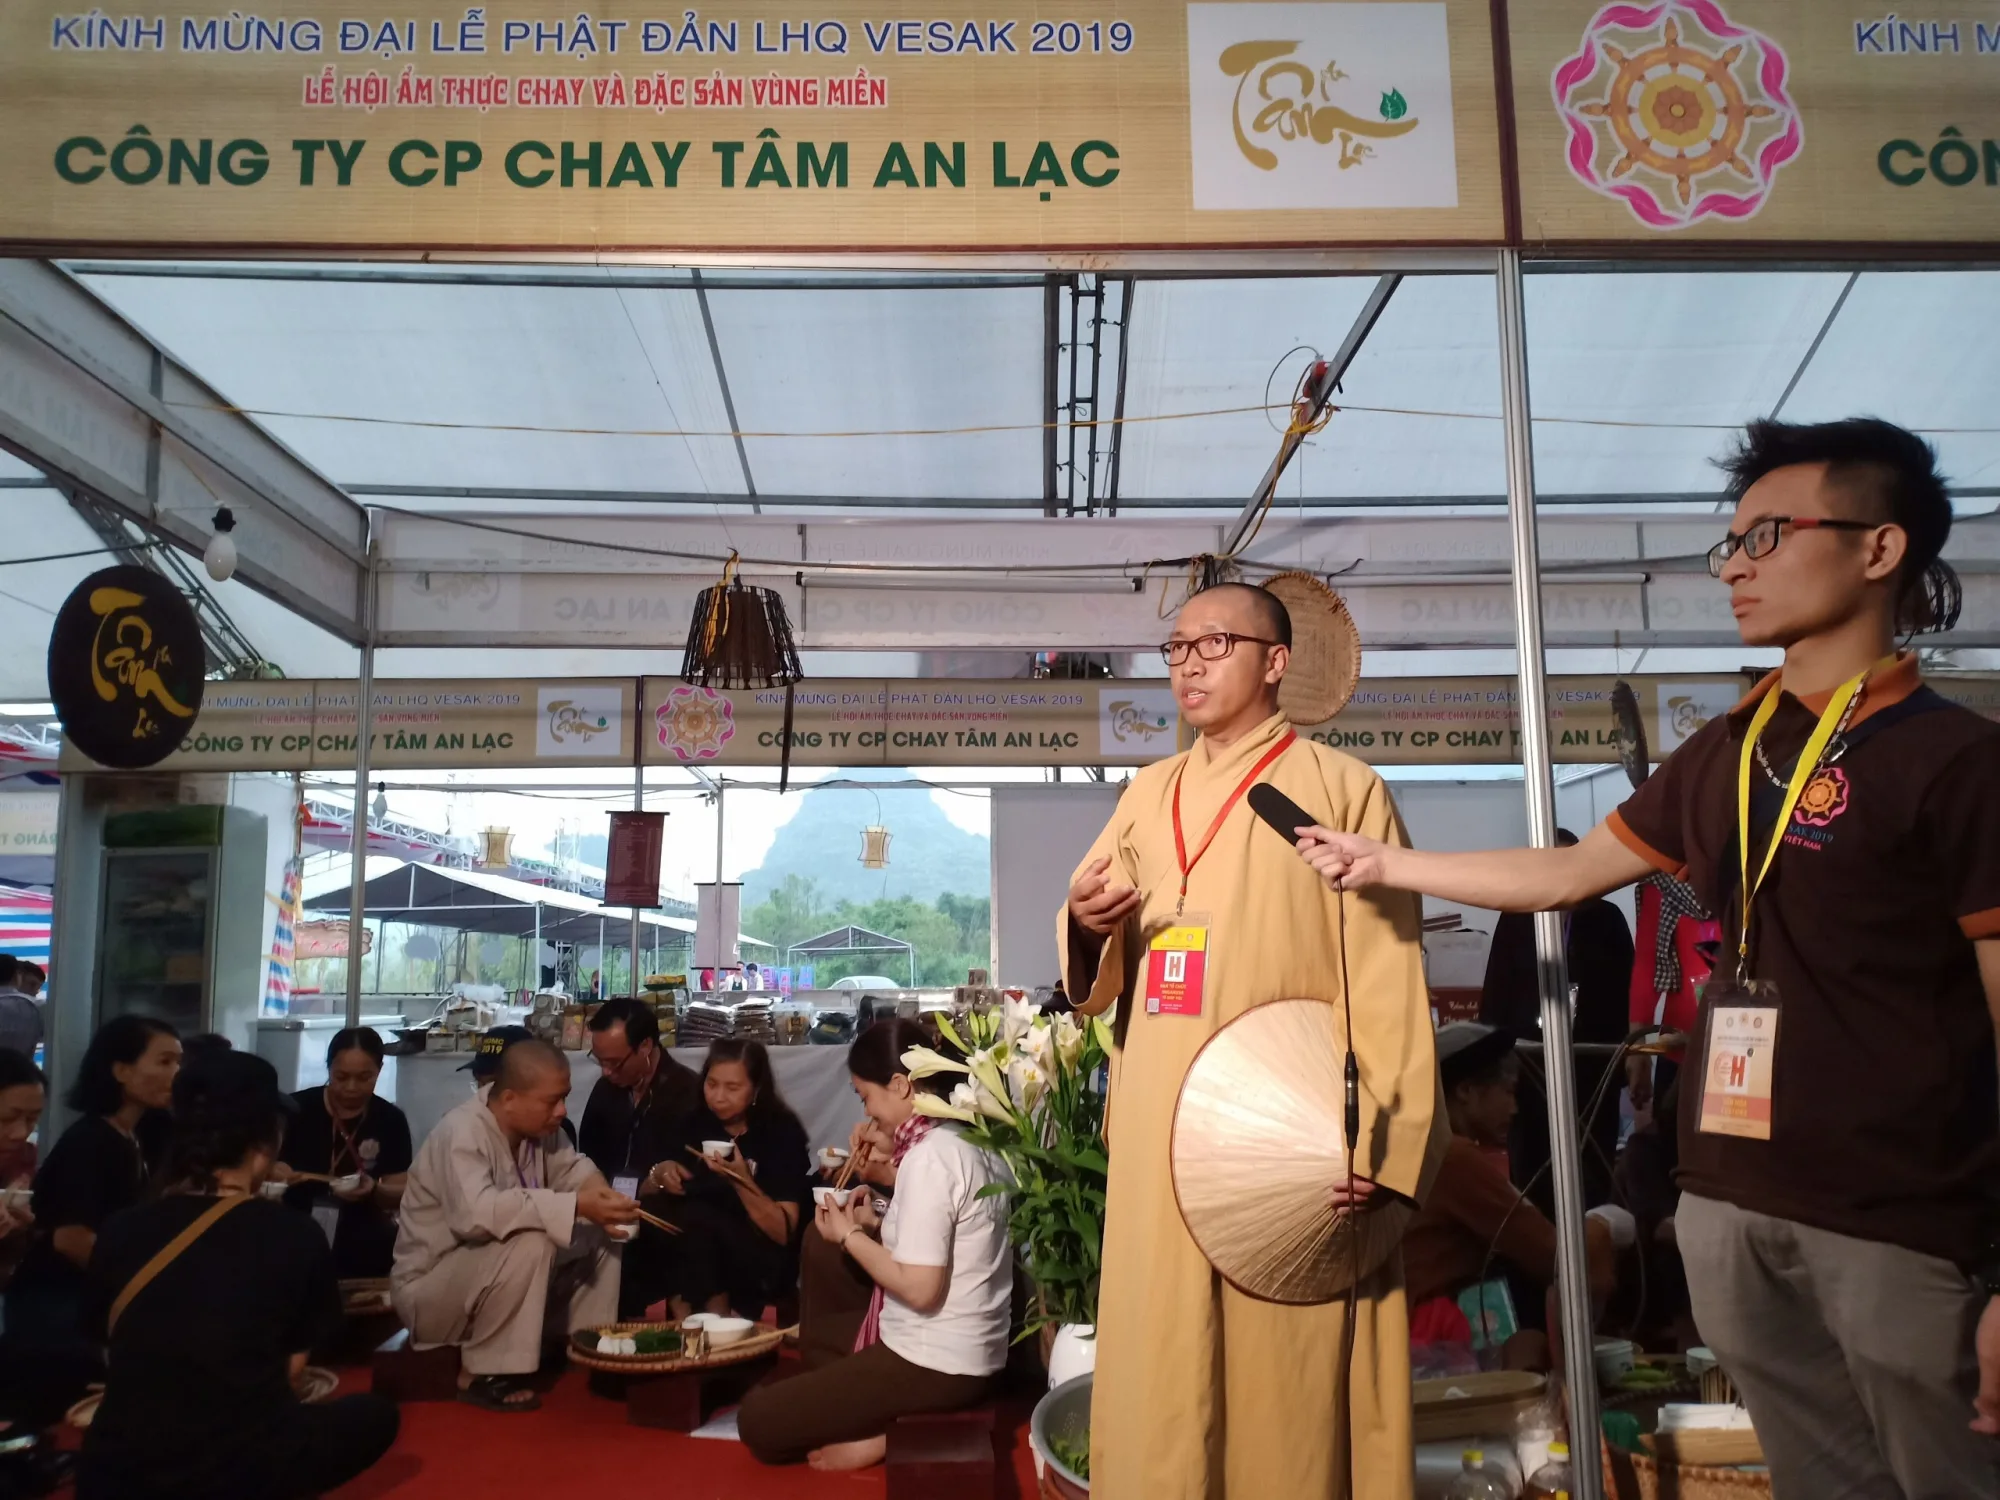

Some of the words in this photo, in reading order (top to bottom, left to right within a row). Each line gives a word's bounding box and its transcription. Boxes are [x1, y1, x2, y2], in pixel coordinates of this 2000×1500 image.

[53, 12, 164, 50] KÍNH
[182, 15, 321, 52] MỪNG
[338, 20, 415, 58] ĐẠI
[432, 9, 486, 53] LỄ
[504, 15, 627, 58] PHẬT
[641, 12, 746, 53] ĐẢN
[756, 21, 847, 54] LHQ
[864, 21, 1017, 53] VESAK
[1032, 22, 1133, 53] 2019
[1856, 14, 1960, 52] KÍNH
[305, 66, 334, 105] LỄ
[343, 75, 388, 111] HỘI
[397, 66, 434, 105] ẨM
[443, 77, 508, 111] THỰC
[516, 78, 585, 106] CHAY
[592, 74, 626, 106] VÀ
[634, 75, 685, 112] ĐẶC
[693, 71, 744, 107] SẢN
[751, 72, 820, 107] VÙNG
[827, 69, 887, 107] MIỀN
[53, 124, 270, 186] CÔNG
[292, 139, 366, 186] TY
[387, 139, 482, 187] CP
[504, 140, 690, 188] CHAY
[712, 128, 848, 188] TÂM
[873, 141, 967, 188] AN
[993, 140, 1120, 202] LẠC
[487, 694, 520, 706] 2019
[1000, 693, 1049, 705] VESAK
[1051, 694, 1083, 706] 2019
[1556, 691, 1603, 702] VESAK
[178, 732, 244, 752] CÔNG
[250, 735, 274, 752] TY
[280, 735, 311, 752] CP
[383, 729, 427, 750] TÂM
[434, 733, 465, 749] AN
[471, 732, 514, 754] LẠC
[757, 727, 823, 748] CÔNG
[828, 731, 851, 748] TY
[857, 731, 887, 748] CP
[892, 731, 950, 748] CHAY
[955, 727, 998, 748] TÂM
[1003, 732, 1033, 748] AN
[1039, 731, 1079, 752] LẠC
[1310, 728, 1376, 748] CÔNG
[1381, 731, 1405, 747] TY
[1410, 731, 1440, 748] CP
[1445, 730, 1504, 748] CHAY
[1560, 729, 1590, 746] AN
[1596, 729, 1622, 750] LẠ
[1811, 828, 1834, 843] 2019
[1168, 956, 1181, 977] H
[1730, 1056, 1747, 1087] H
